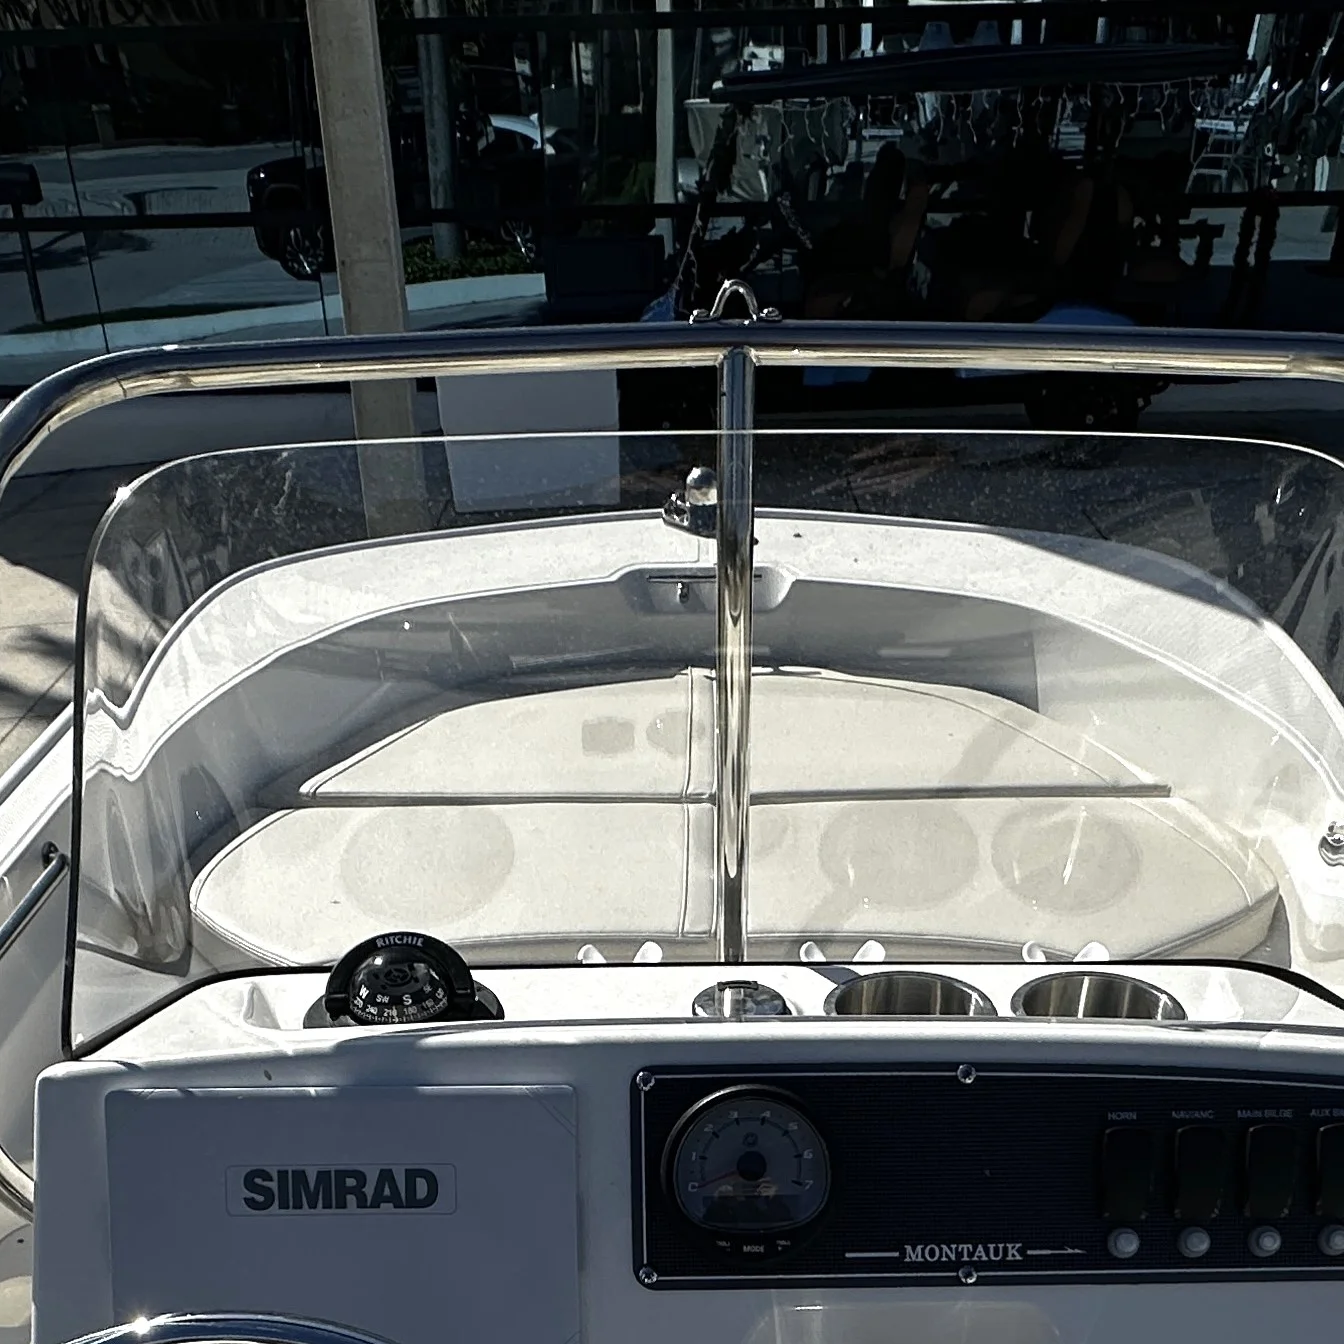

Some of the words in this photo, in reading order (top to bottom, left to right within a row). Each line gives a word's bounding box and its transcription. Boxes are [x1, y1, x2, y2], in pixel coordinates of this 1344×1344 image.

[375, 933, 425, 949] RITCHIE
[402, 994, 413, 1006] S
[728, 1111, 739, 1119] 3
[761, 1110, 771, 1118] 4
[1107, 1111, 1137, 1120] HORN
[1237, 1109, 1262, 1118] MAIN
[1264, 1109, 1293, 1118] BILGE
[1309, 1108, 1331, 1117] AUX
[704, 1124, 714, 1132] 2
[788, 1122, 799, 1130] 5
[803, 1149, 813, 1159] 6
[242, 1167, 439, 1211] SIMRAD
[804, 1180, 814, 1190] 7
[740, 1245, 765, 1253] MODE
[903, 1242, 1024, 1263] MONTAUK
